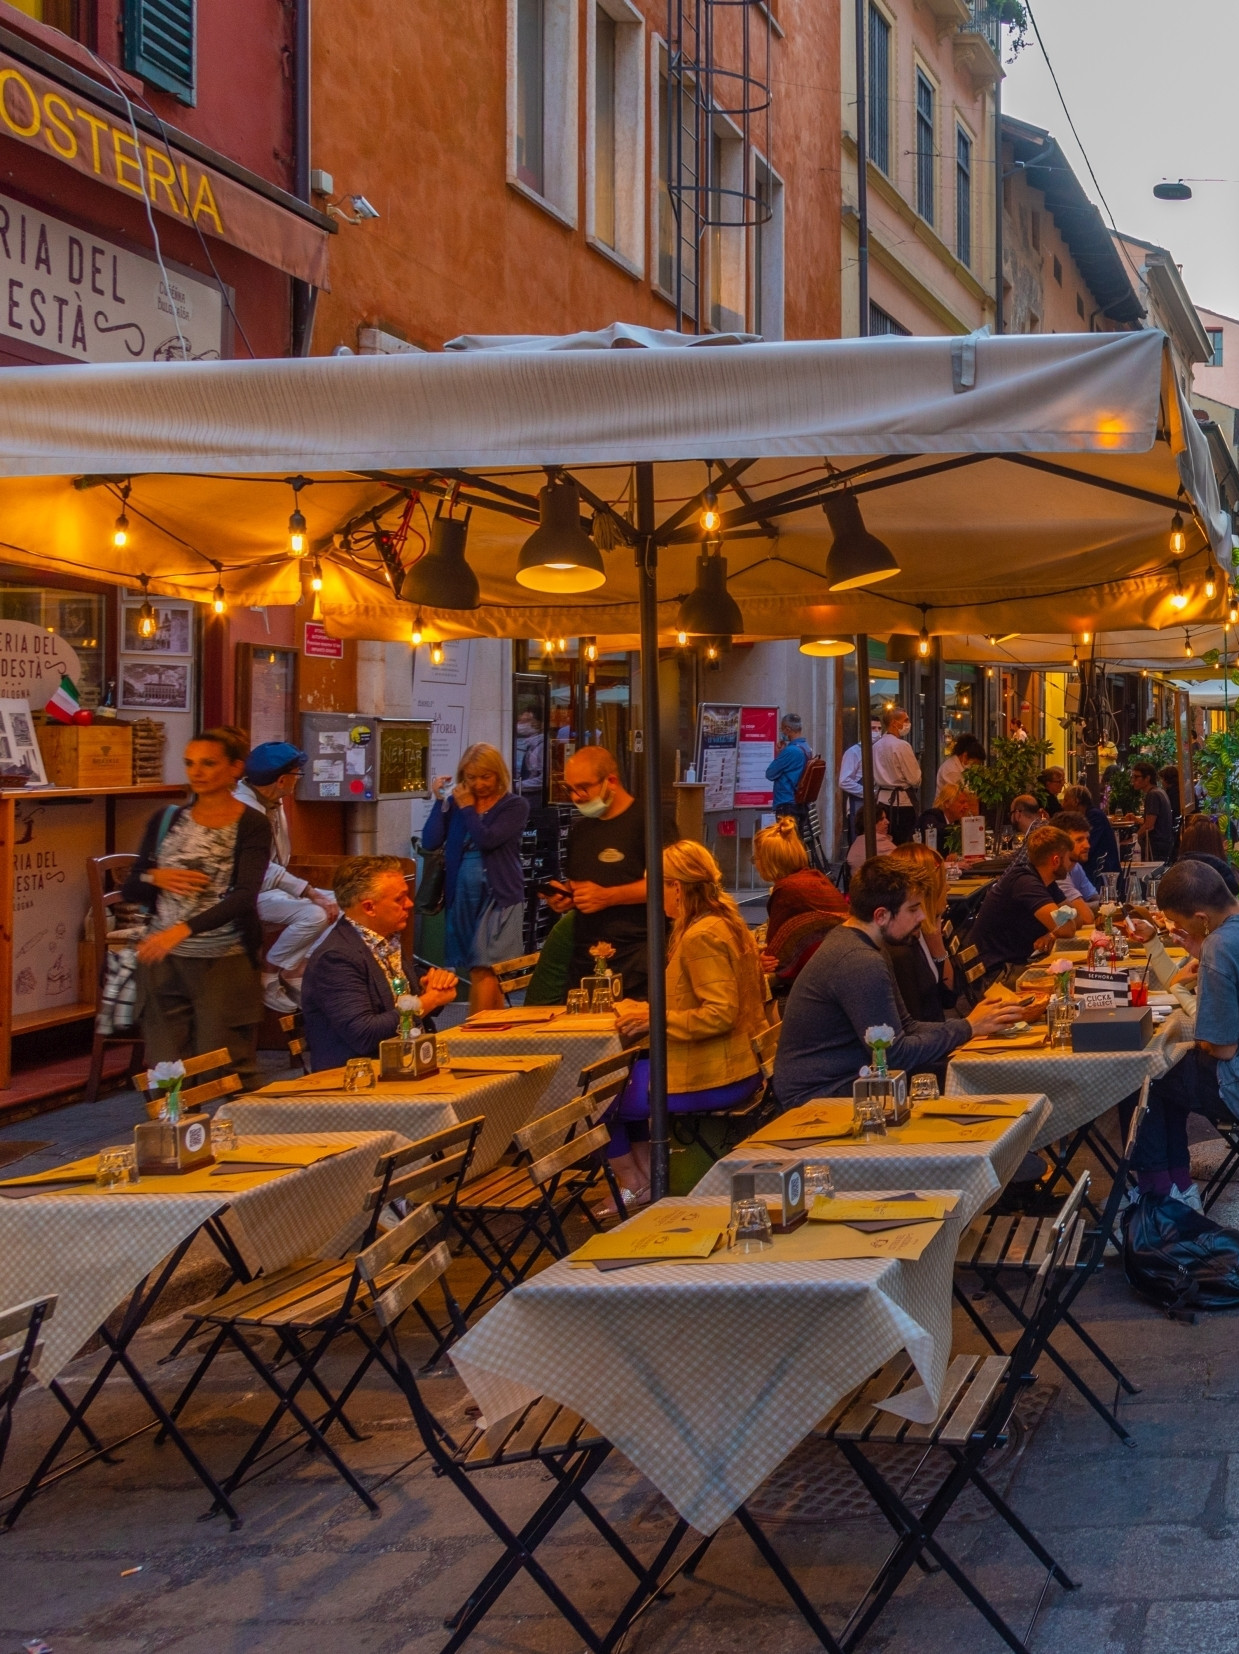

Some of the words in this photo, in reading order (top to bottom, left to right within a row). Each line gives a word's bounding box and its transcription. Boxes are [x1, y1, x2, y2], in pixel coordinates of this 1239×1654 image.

[0, 69, 224, 235] OSTERIA
[68, 235, 126, 305] DEL
[9, 278, 87, 353] ESTÀ
[34, 636, 58, 656] DEL
[1, 656, 42, 679] DESTÀ
[37, 851, 58, 868] DEL
[1087, 1000, 1113, 1008] COLLECT
